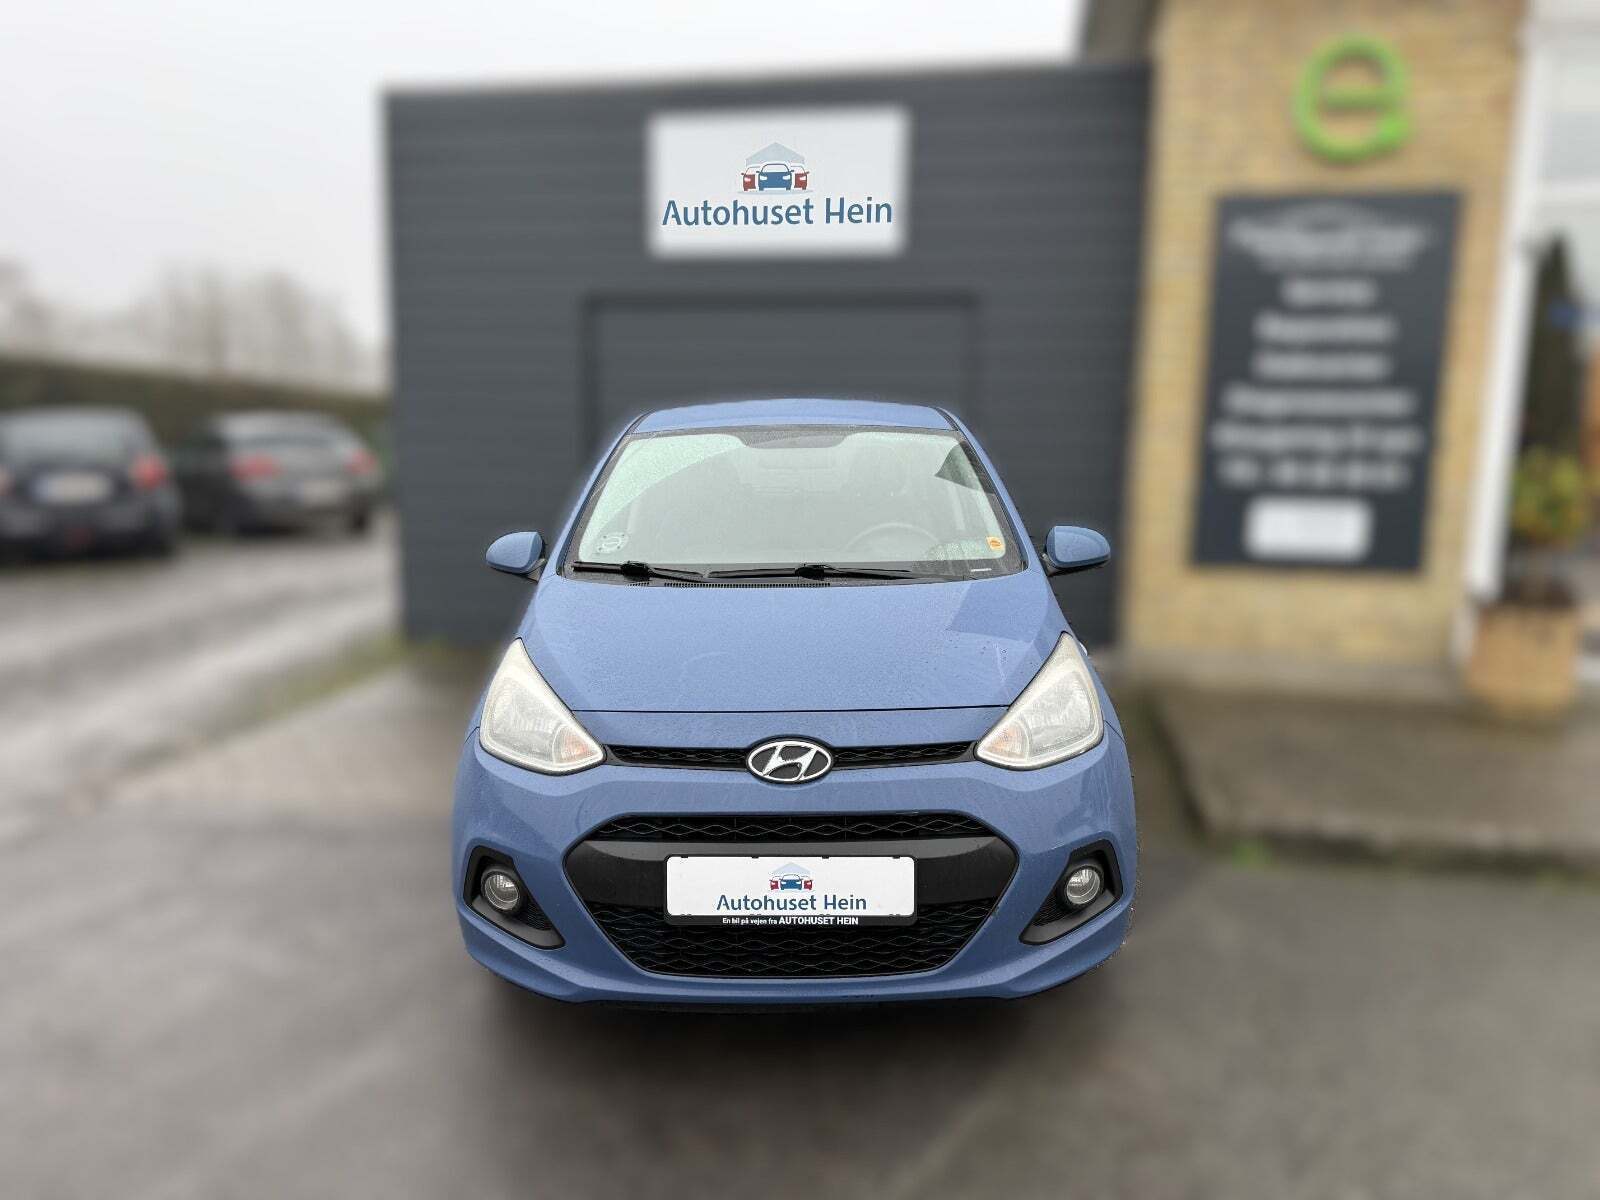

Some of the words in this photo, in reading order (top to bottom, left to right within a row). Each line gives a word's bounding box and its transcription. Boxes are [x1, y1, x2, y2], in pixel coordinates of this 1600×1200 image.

[662, 198, 814, 226] Autohuset
[825, 196, 893, 224] Hein
[716, 894, 817, 911] Autohuset
[824, 894, 867, 911] Hein
[750, 917, 767, 926] vejen
[768, 917, 777, 925] fra
[778, 916, 834, 925] AUTOHUSET
[836, 916, 859, 925] HEIN
